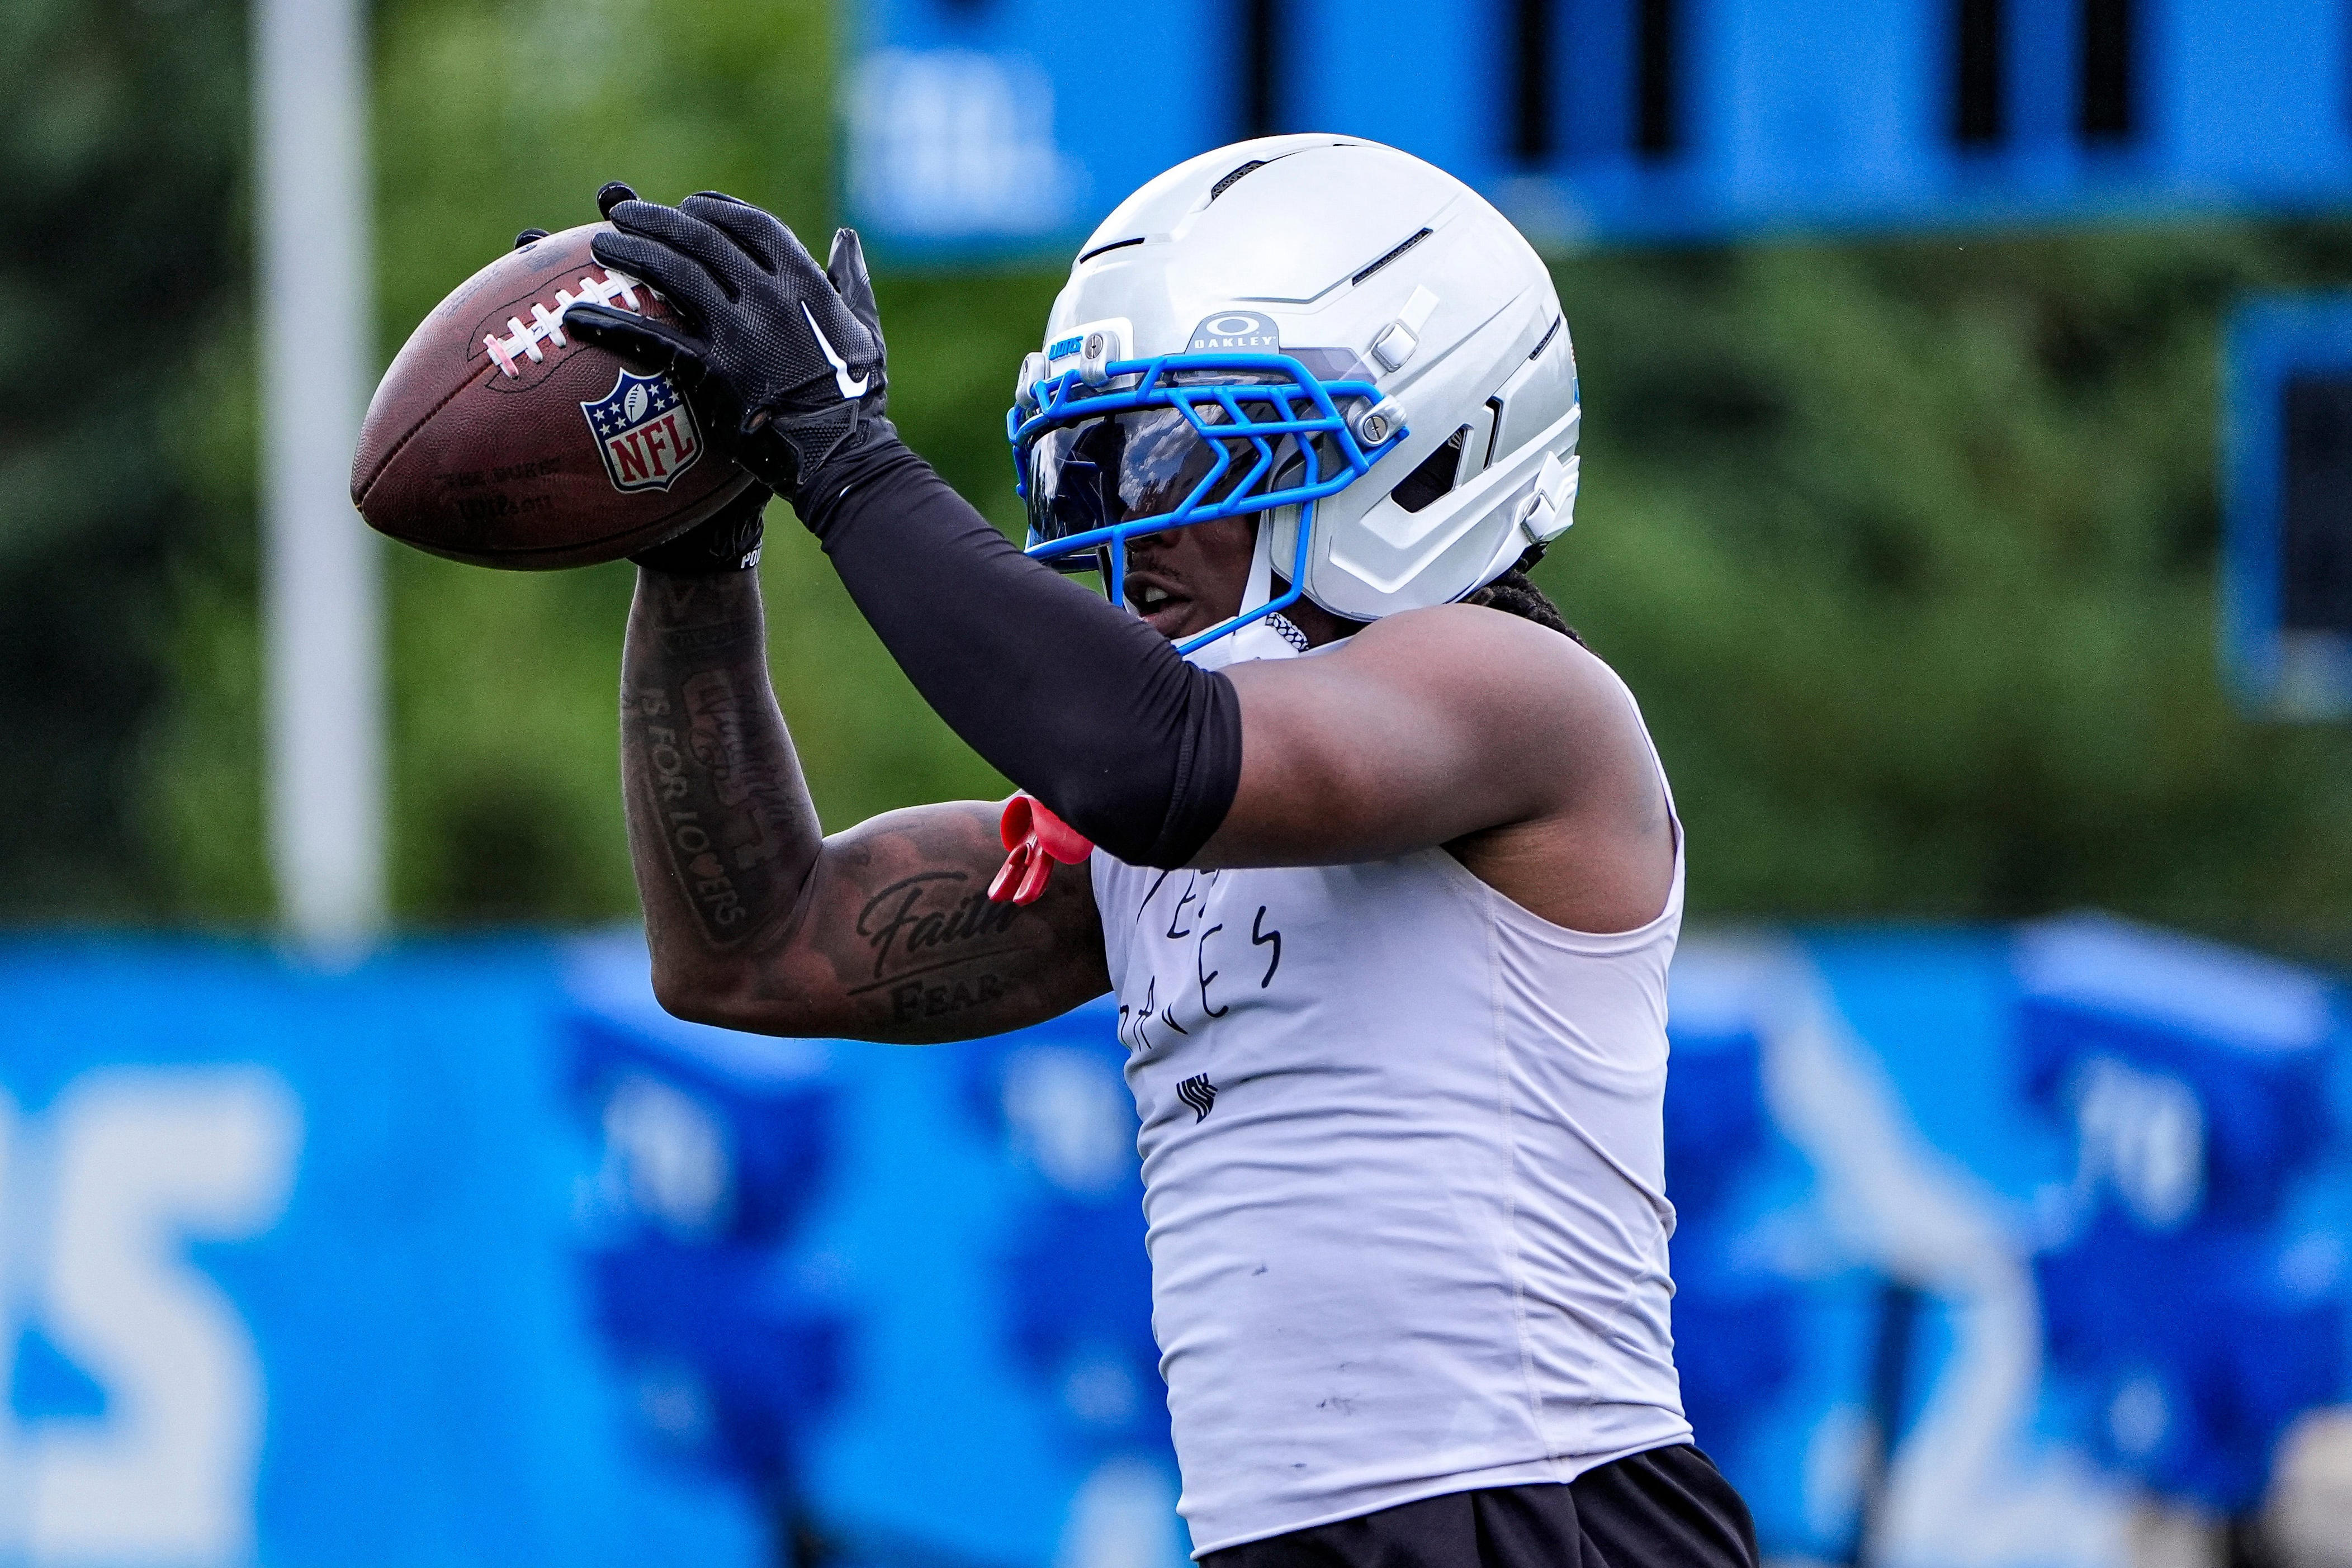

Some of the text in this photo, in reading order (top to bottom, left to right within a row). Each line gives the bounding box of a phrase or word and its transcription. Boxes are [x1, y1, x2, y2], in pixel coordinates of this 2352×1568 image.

[1194, 336, 1273, 349] OAKLEY
[610, 414, 694, 482] NFL
[640, 688, 670, 716] IS
[648, 726, 688, 802] FOR
[891, 963, 1005, 1013] FEAR
